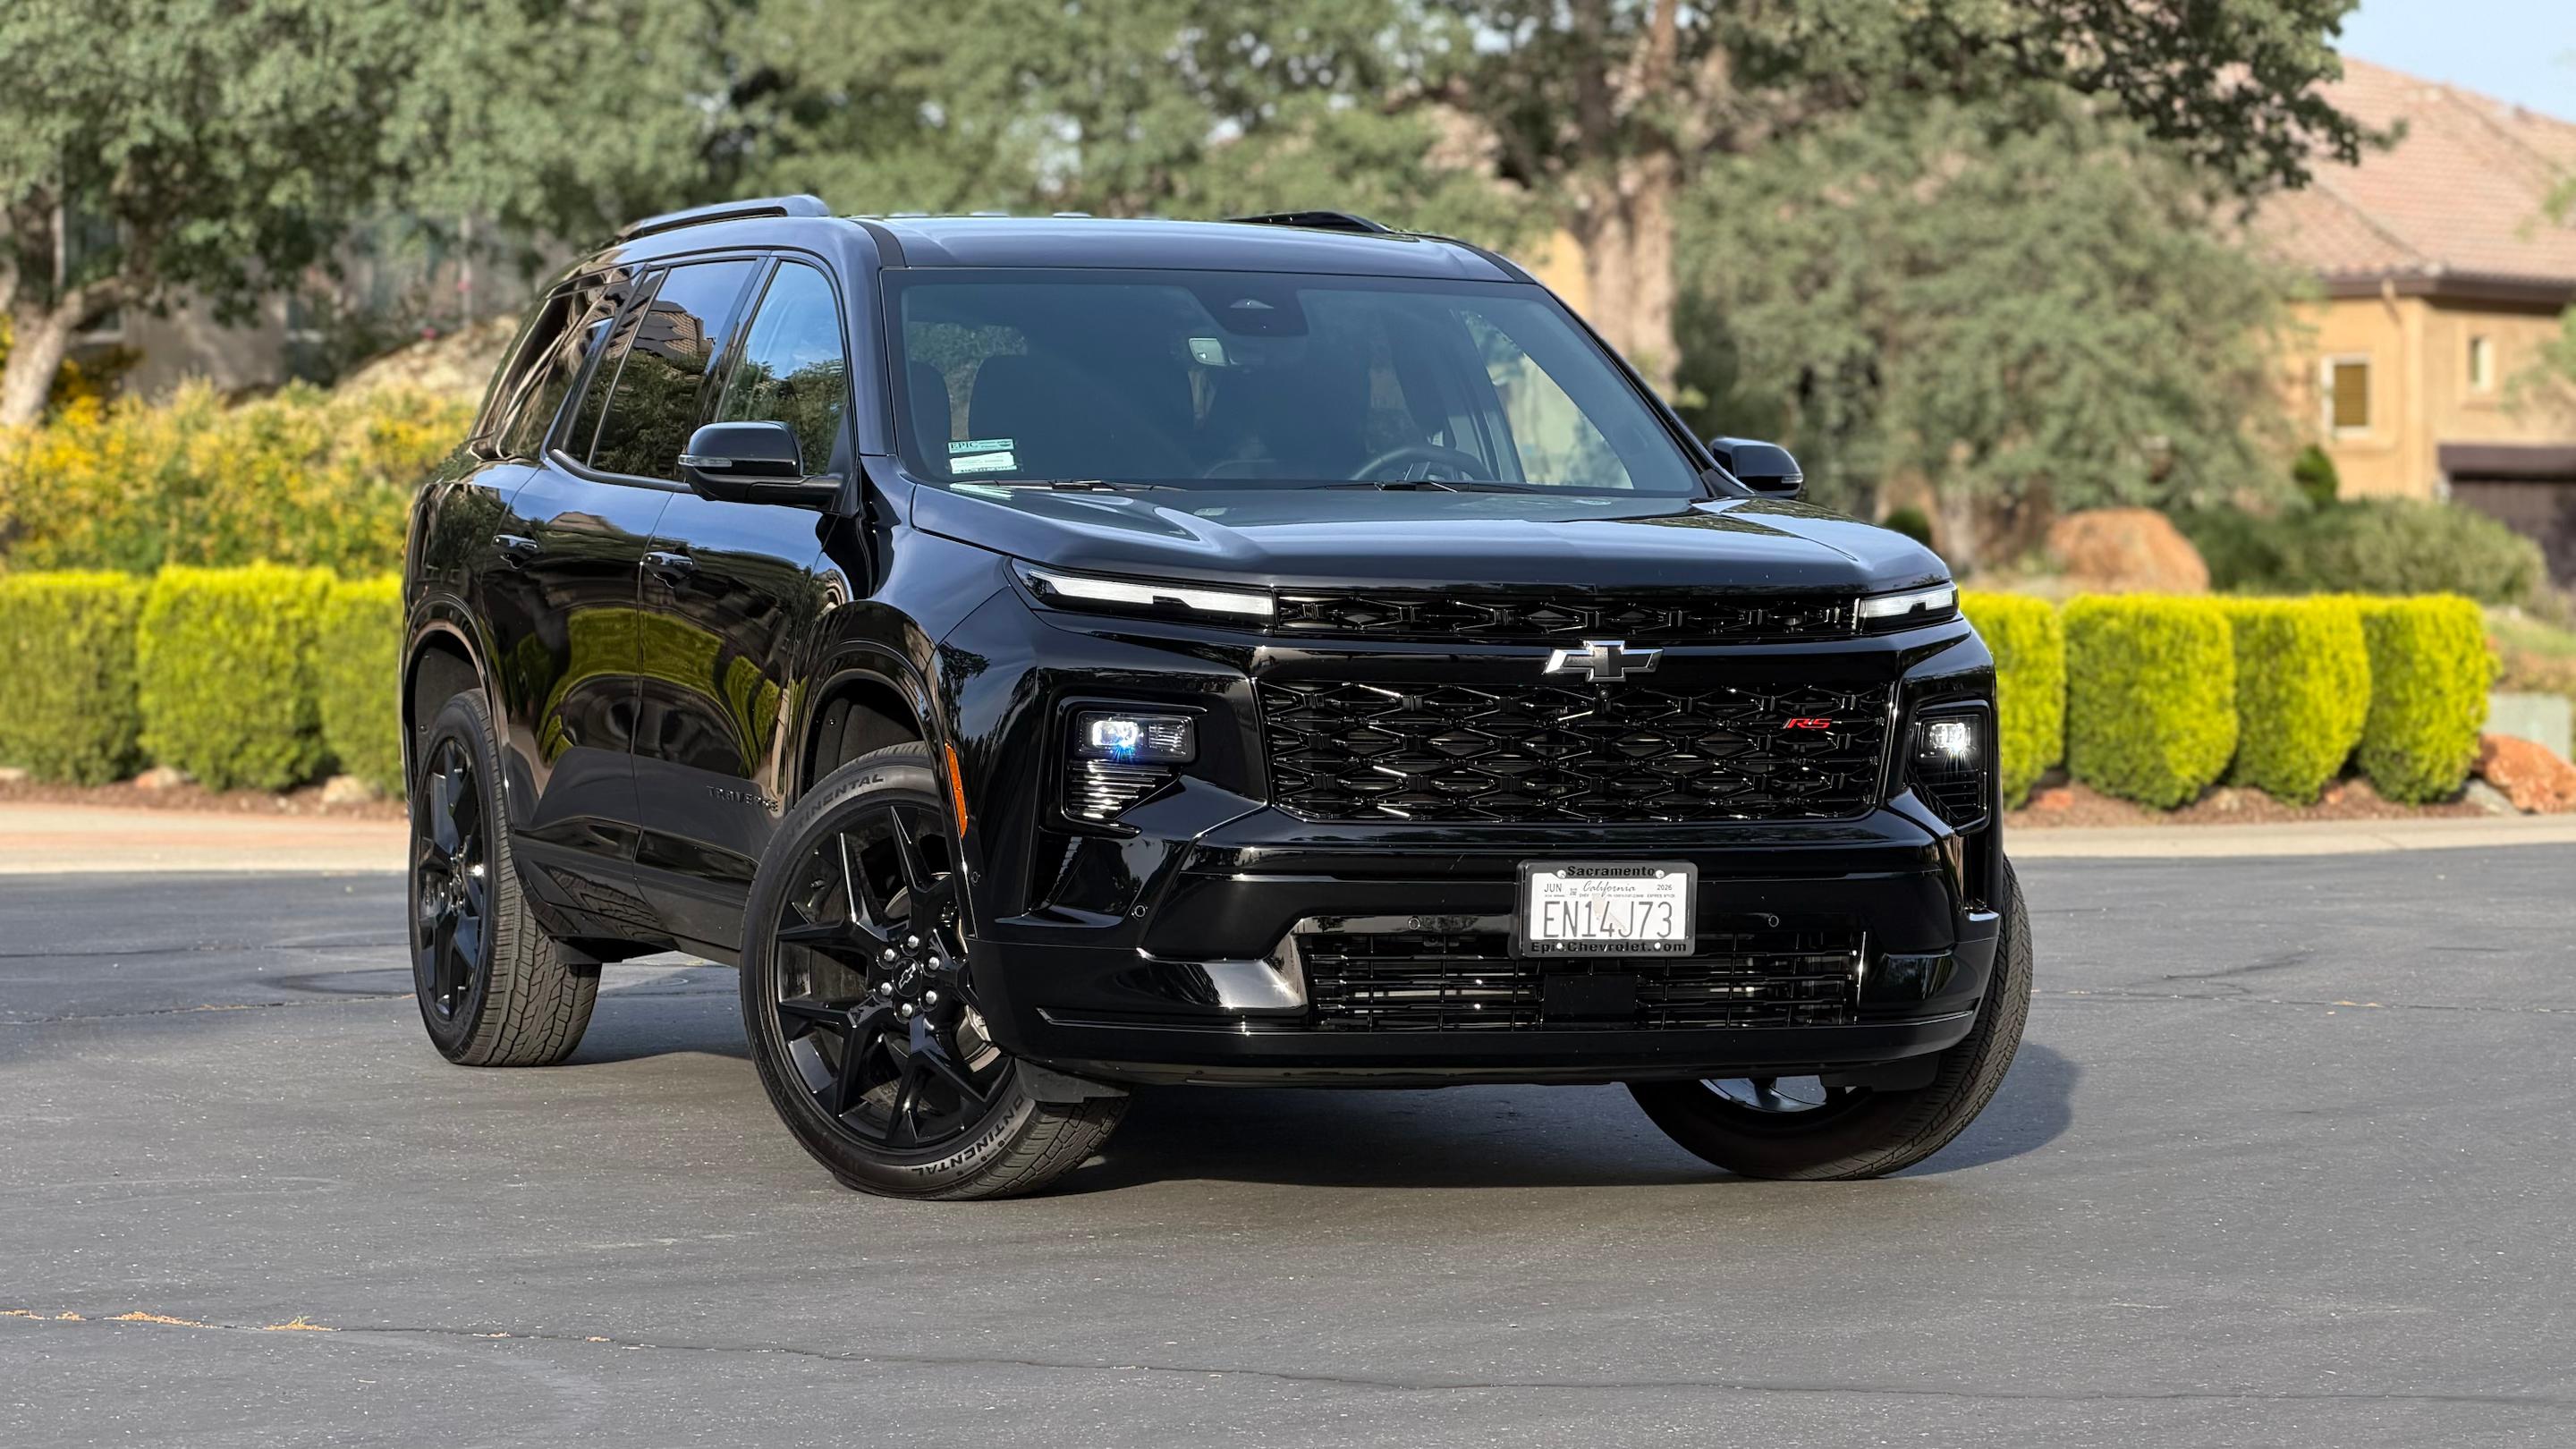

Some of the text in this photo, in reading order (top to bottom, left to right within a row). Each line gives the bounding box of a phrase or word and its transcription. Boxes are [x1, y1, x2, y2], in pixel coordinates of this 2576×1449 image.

[1786, 717, 1832, 729] RS
[1567, 866, 1655, 877] Sacramento
[1544, 883, 1563, 893] JUN
[1583, 880, 1636, 898] California
[1657, 884, 1673, 892] 2026
[1543, 901, 1673, 938] EN14J73
[911, 1094, 1024, 1177] ONTINENTAL
